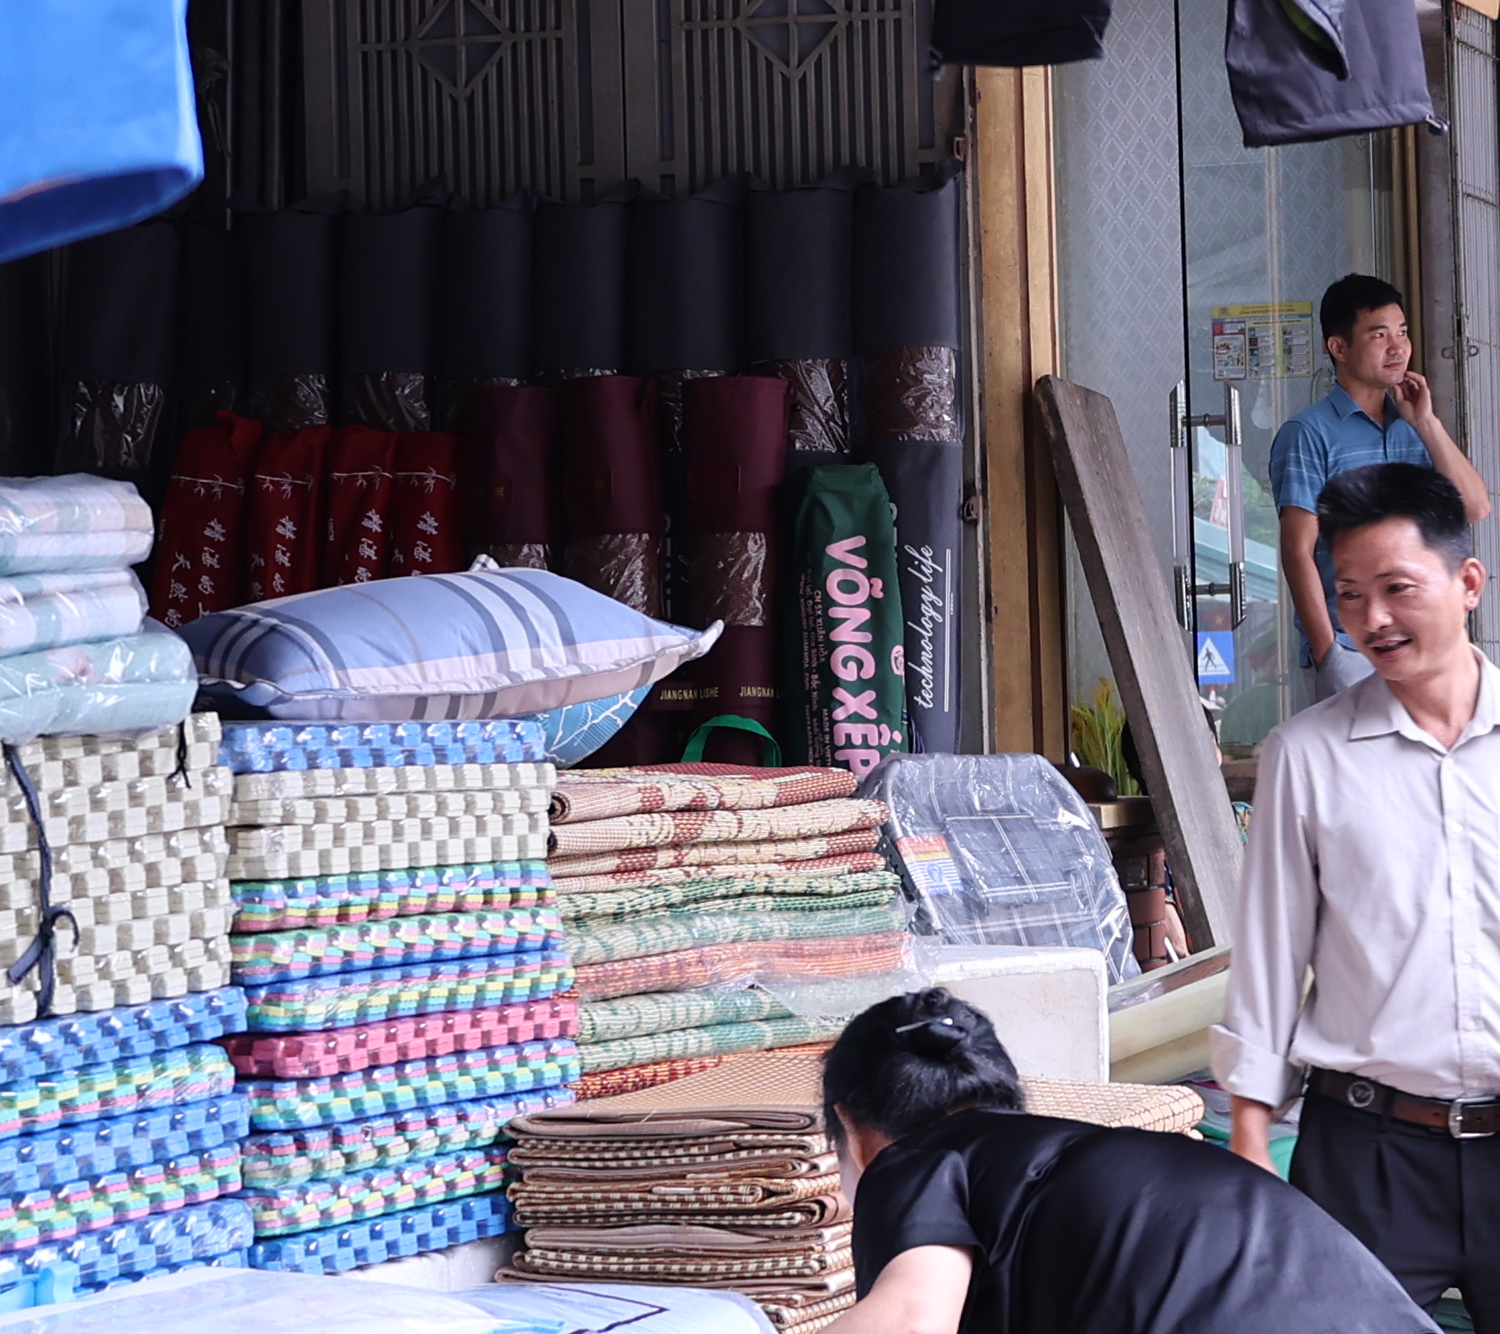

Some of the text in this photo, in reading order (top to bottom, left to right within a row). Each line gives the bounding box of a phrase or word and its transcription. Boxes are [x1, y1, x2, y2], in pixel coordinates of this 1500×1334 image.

[825, 535, 904, 776] VÕNG XẾP
[904, 544, 943, 709] technology life
